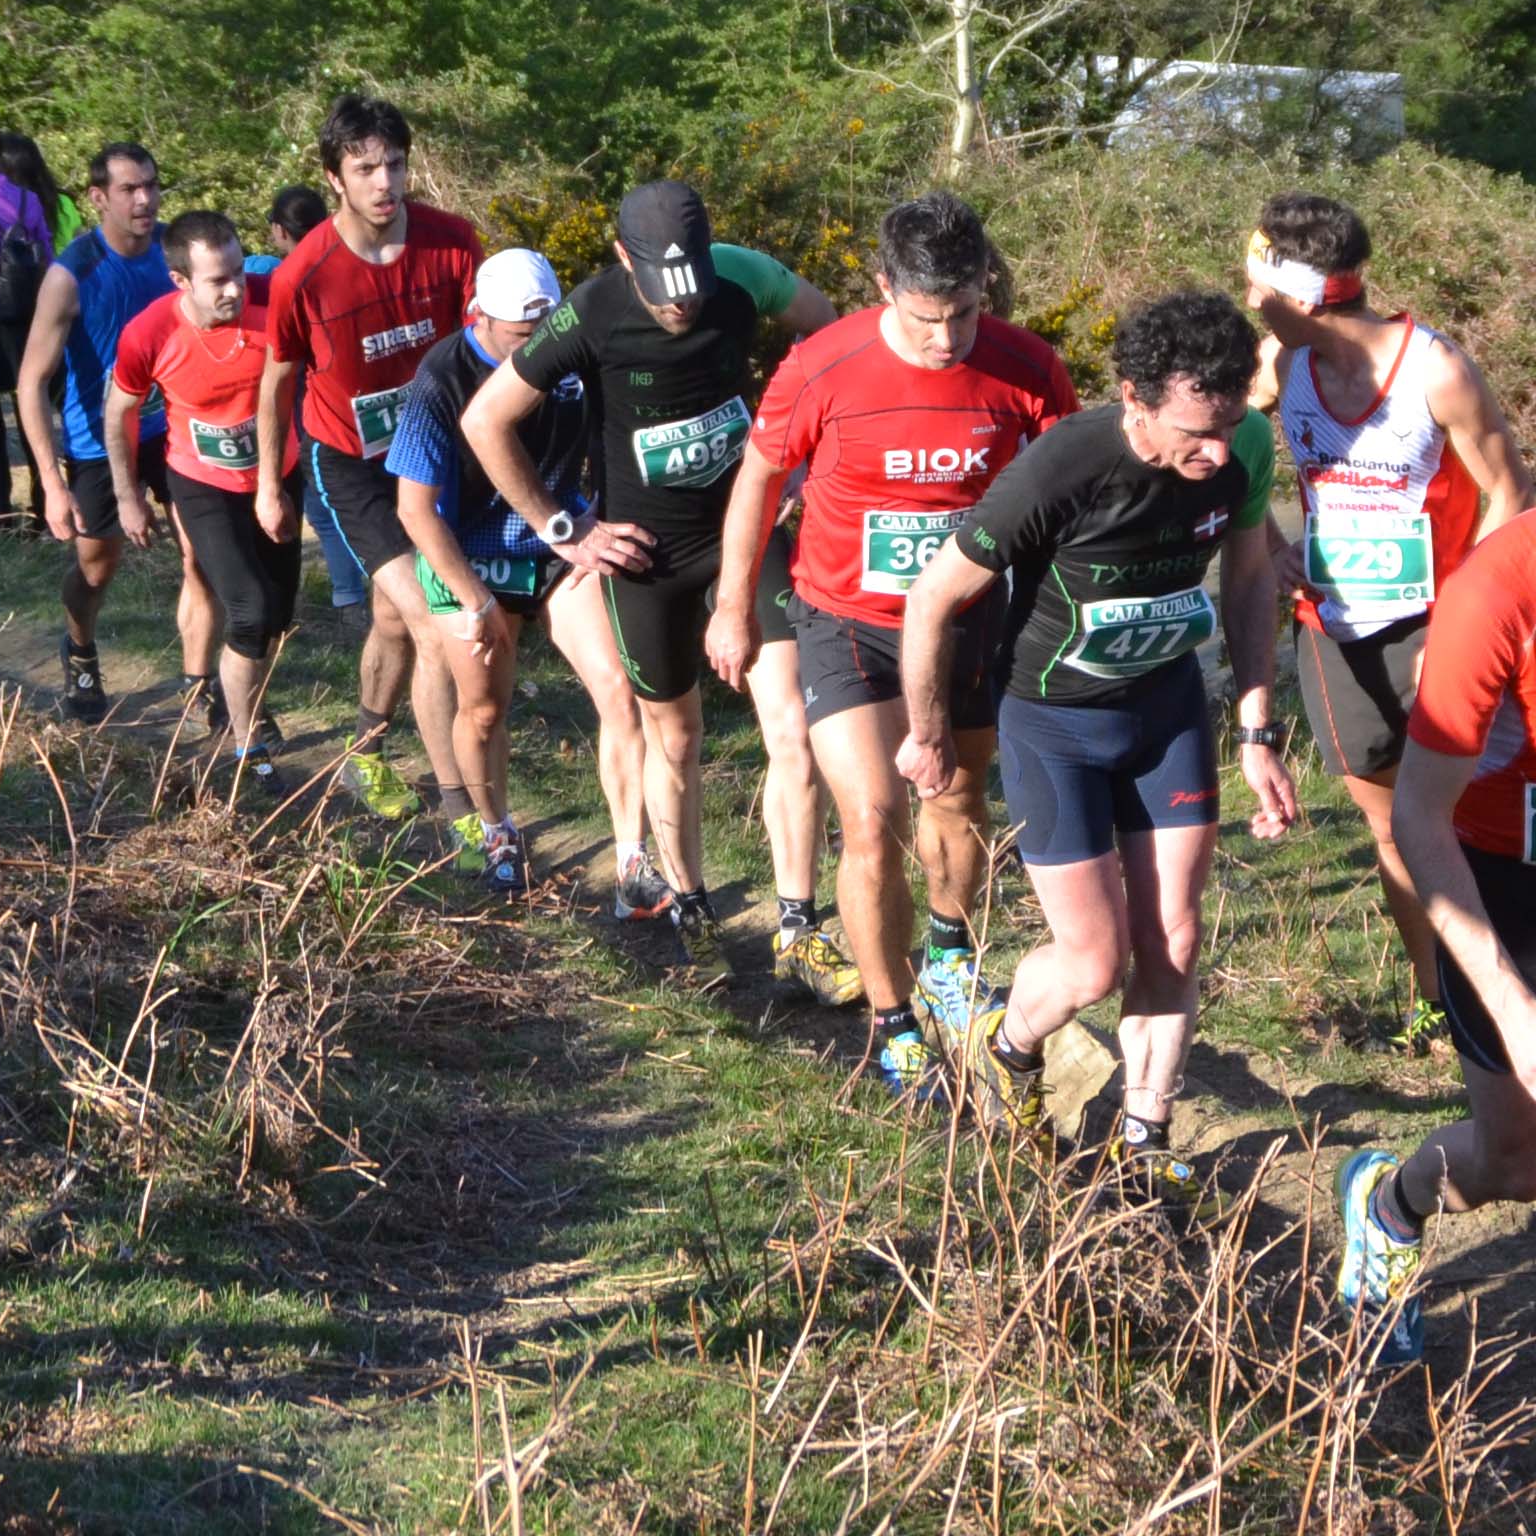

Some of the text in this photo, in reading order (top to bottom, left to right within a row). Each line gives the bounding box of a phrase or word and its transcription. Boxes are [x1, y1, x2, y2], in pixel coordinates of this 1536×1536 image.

[362, 318, 436, 355] STREBEL
[647, 430, 686, 446] CAJA
[688, 406, 737, 436] RURAL
[218, 435, 253, 457] 61
[665, 432, 728, 475] 498
[885, 448, 990, 474] BIOK
[878, 515, 921, 530] CAJA
[1328, 540, 1403, 579] 229
[1100, 594, 1202, 623] CAJA RURAL
[1104, 623, 1189, 659] 477
